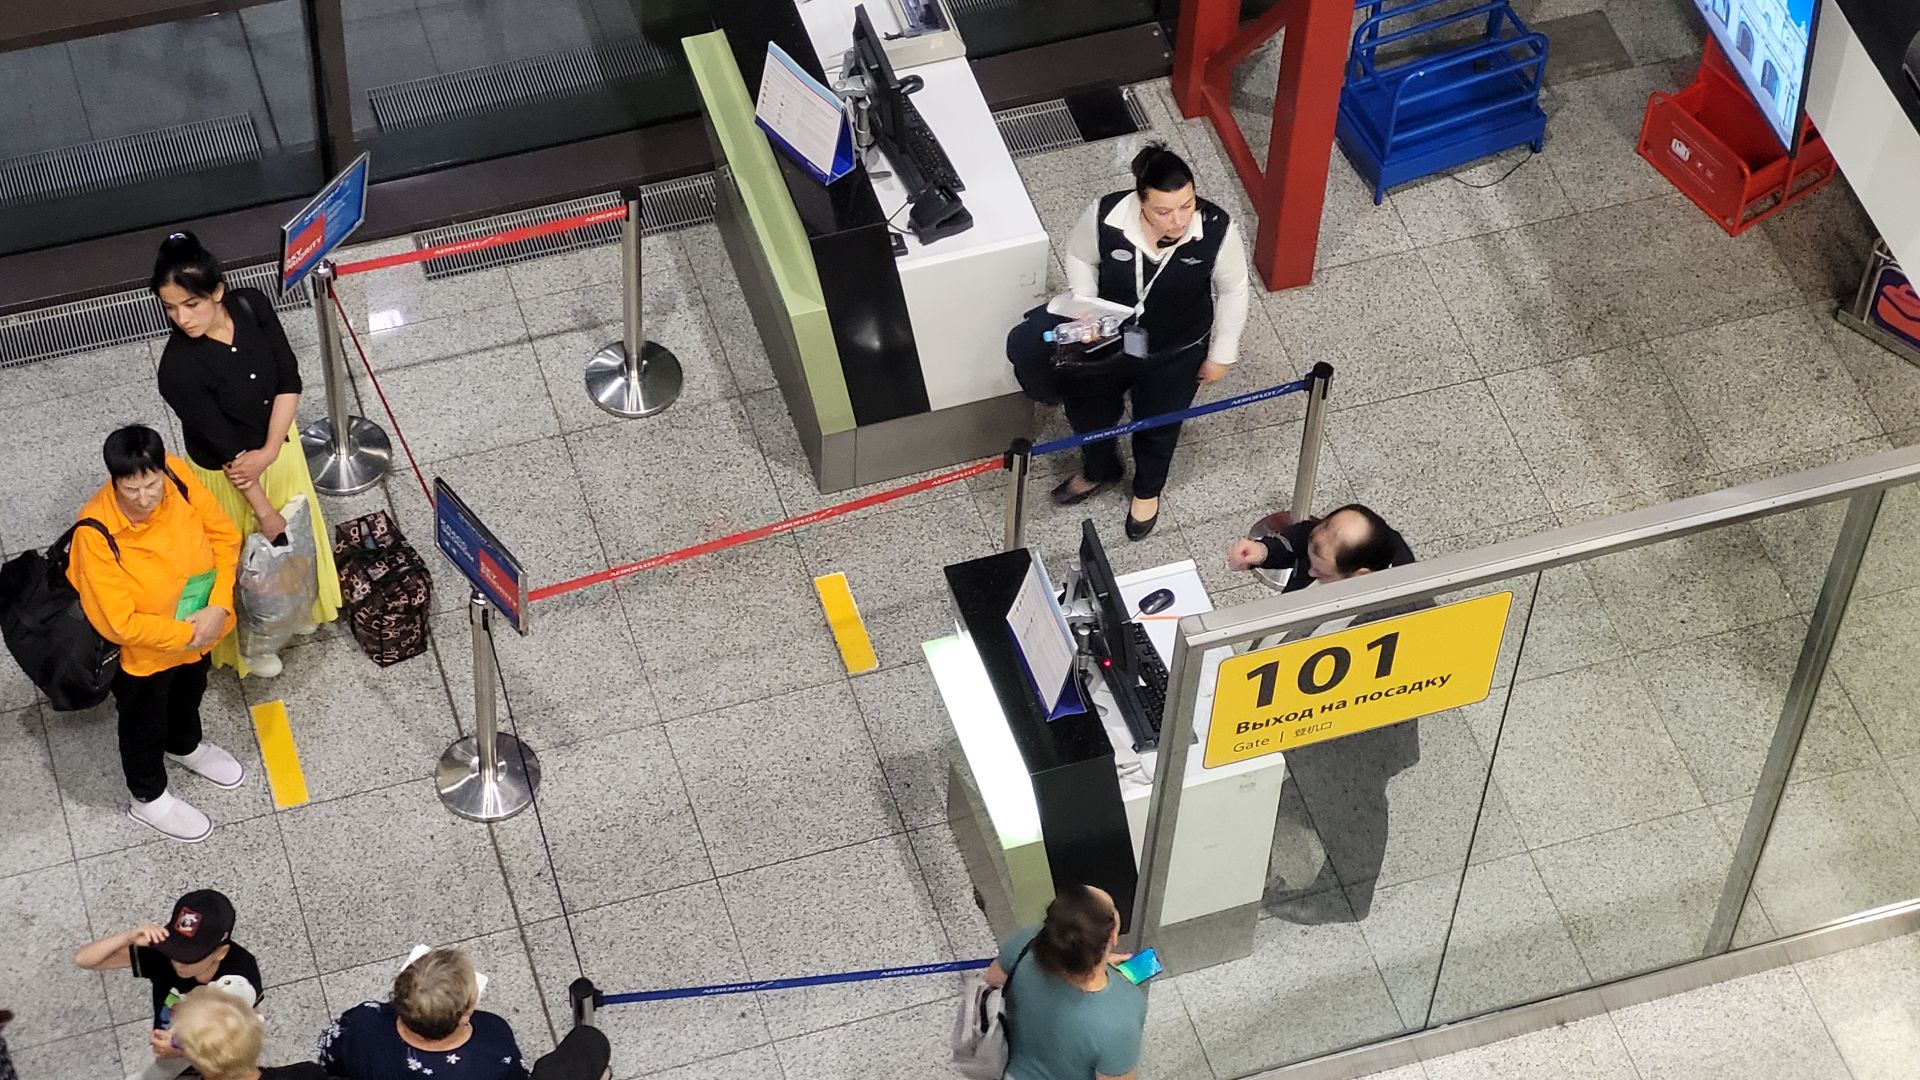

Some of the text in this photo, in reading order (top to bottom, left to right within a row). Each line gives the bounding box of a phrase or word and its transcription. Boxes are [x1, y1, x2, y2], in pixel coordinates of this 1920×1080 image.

[585, 208, 627, 223] AEROFLO
[286, 247, 303, 264] SKY
[434, 241, 480, 255] AEROFLOT
[1231, 389, 1277, 406] AEROFLOT
[1082, 426, 1129, 441] AEROFLOT
[931, 469, 977, 486] AEROFLOT
[771, 515, 818, 532] AEROFLOT
[609, 561, 656, 577] AEROFLOT
[1246, 631, 1400, 709] 101
[1235, 673, 1453, 735] Выход на посадку
[1233, 721, 1333, 753] Gate 登机口
[880, 966, 934, 977] AEROFLOT
[701, 984, 757, 995] AEROFLOT
